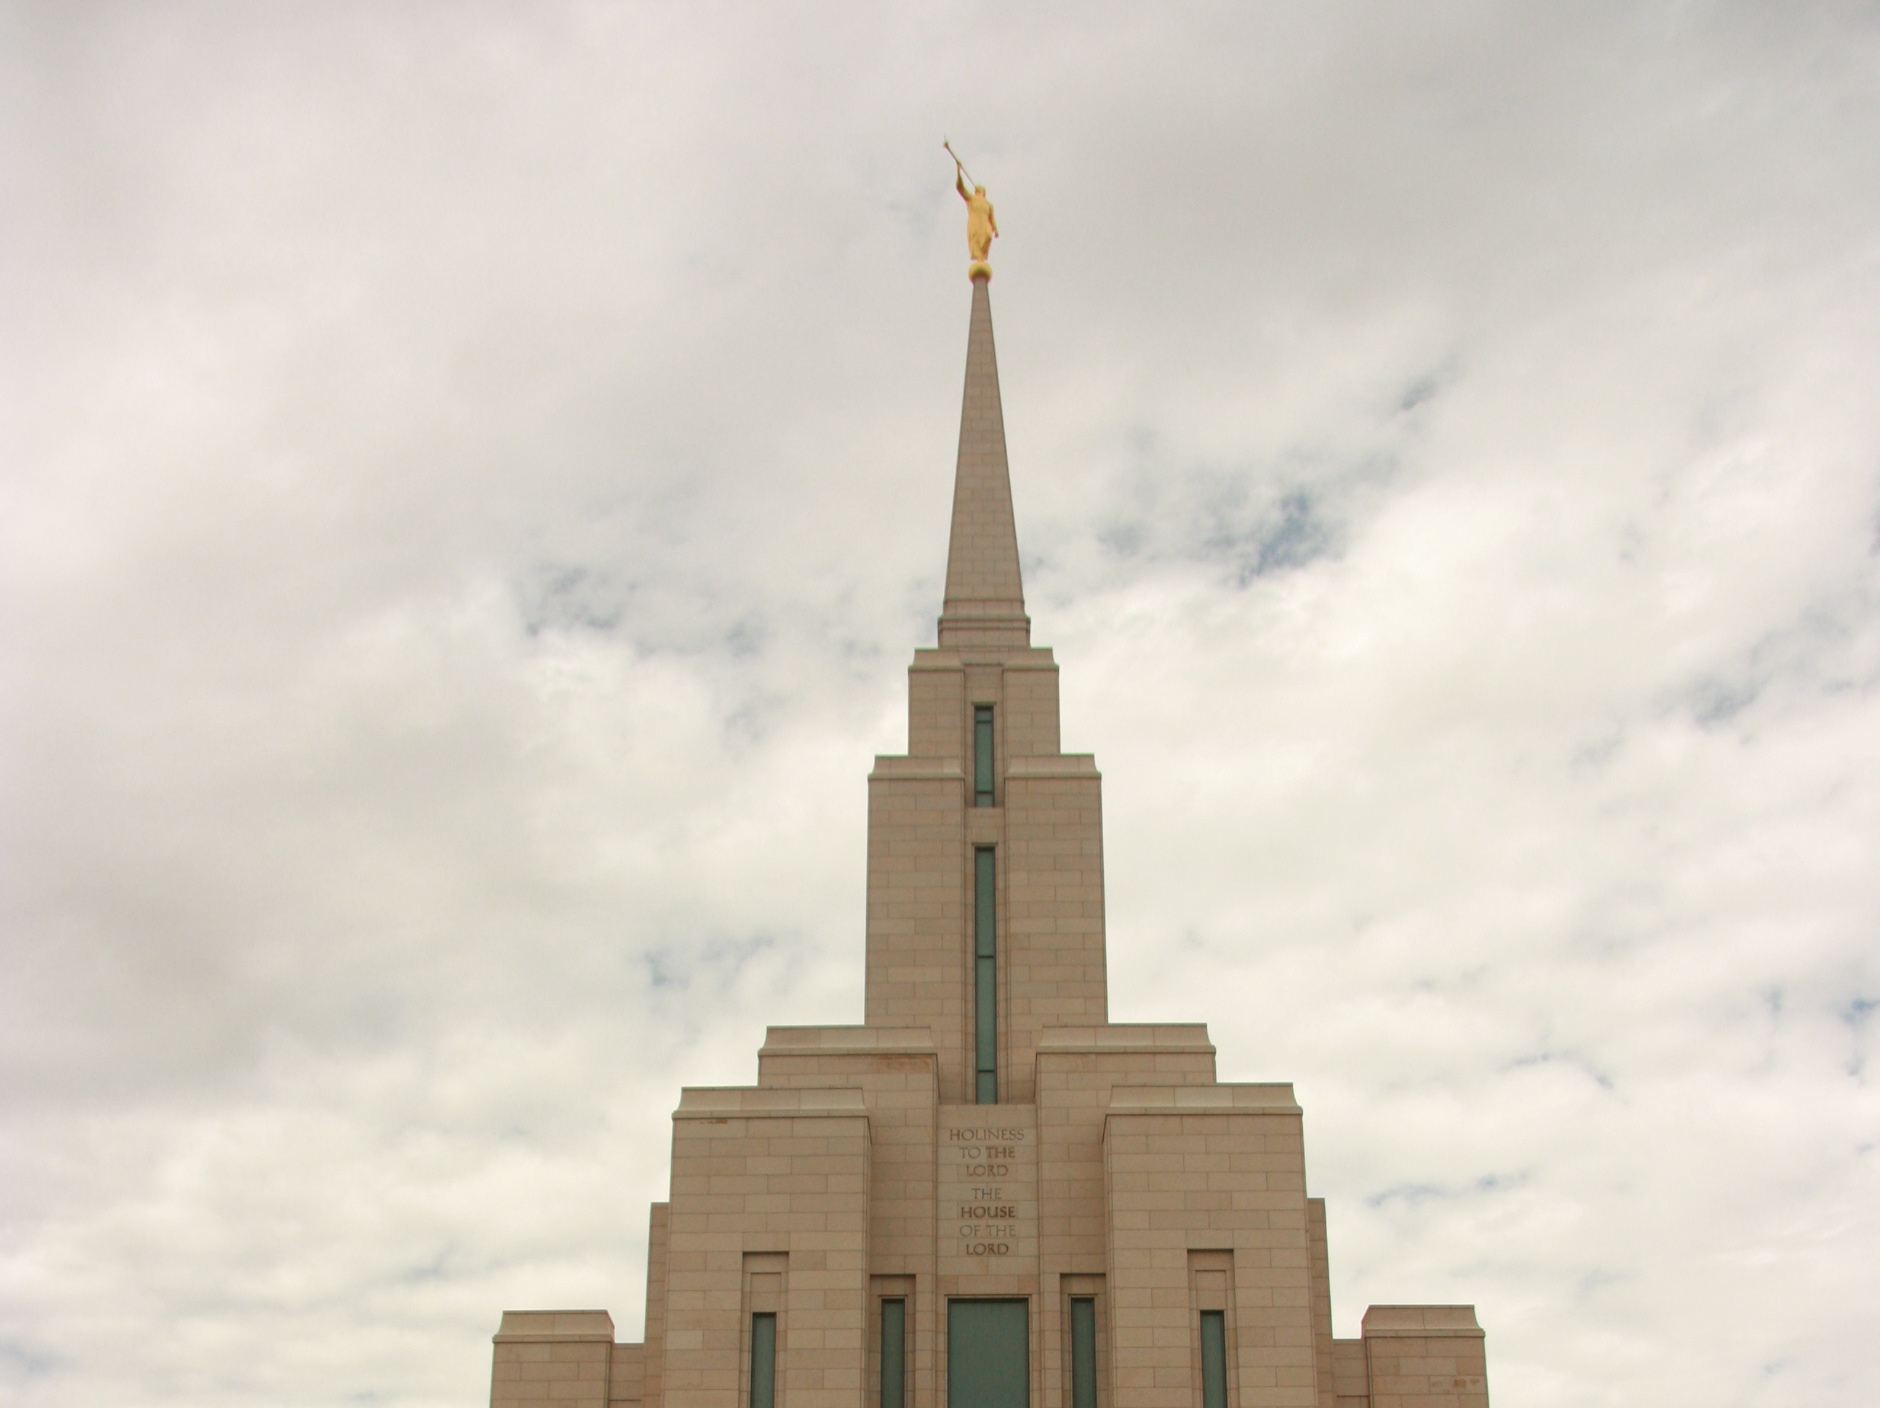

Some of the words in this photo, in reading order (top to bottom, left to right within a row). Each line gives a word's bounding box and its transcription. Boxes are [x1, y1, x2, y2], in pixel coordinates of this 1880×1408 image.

[949, 1129, 1025, 1141] HOLINESS
[959, 1147, 981, 1159] TO
[986, 1146, 1016, 1159] THE
[966, 1165, 1009, 1177] LORD
[971, 1187, 1003, 1200] THE
[961, 1206, 1016, 1218] HOUSE
[959, 1224, 981, 1237] OF
[986, 1224, 1017, 1237] THE
[966, 1243, 1009, 1256] LORD
